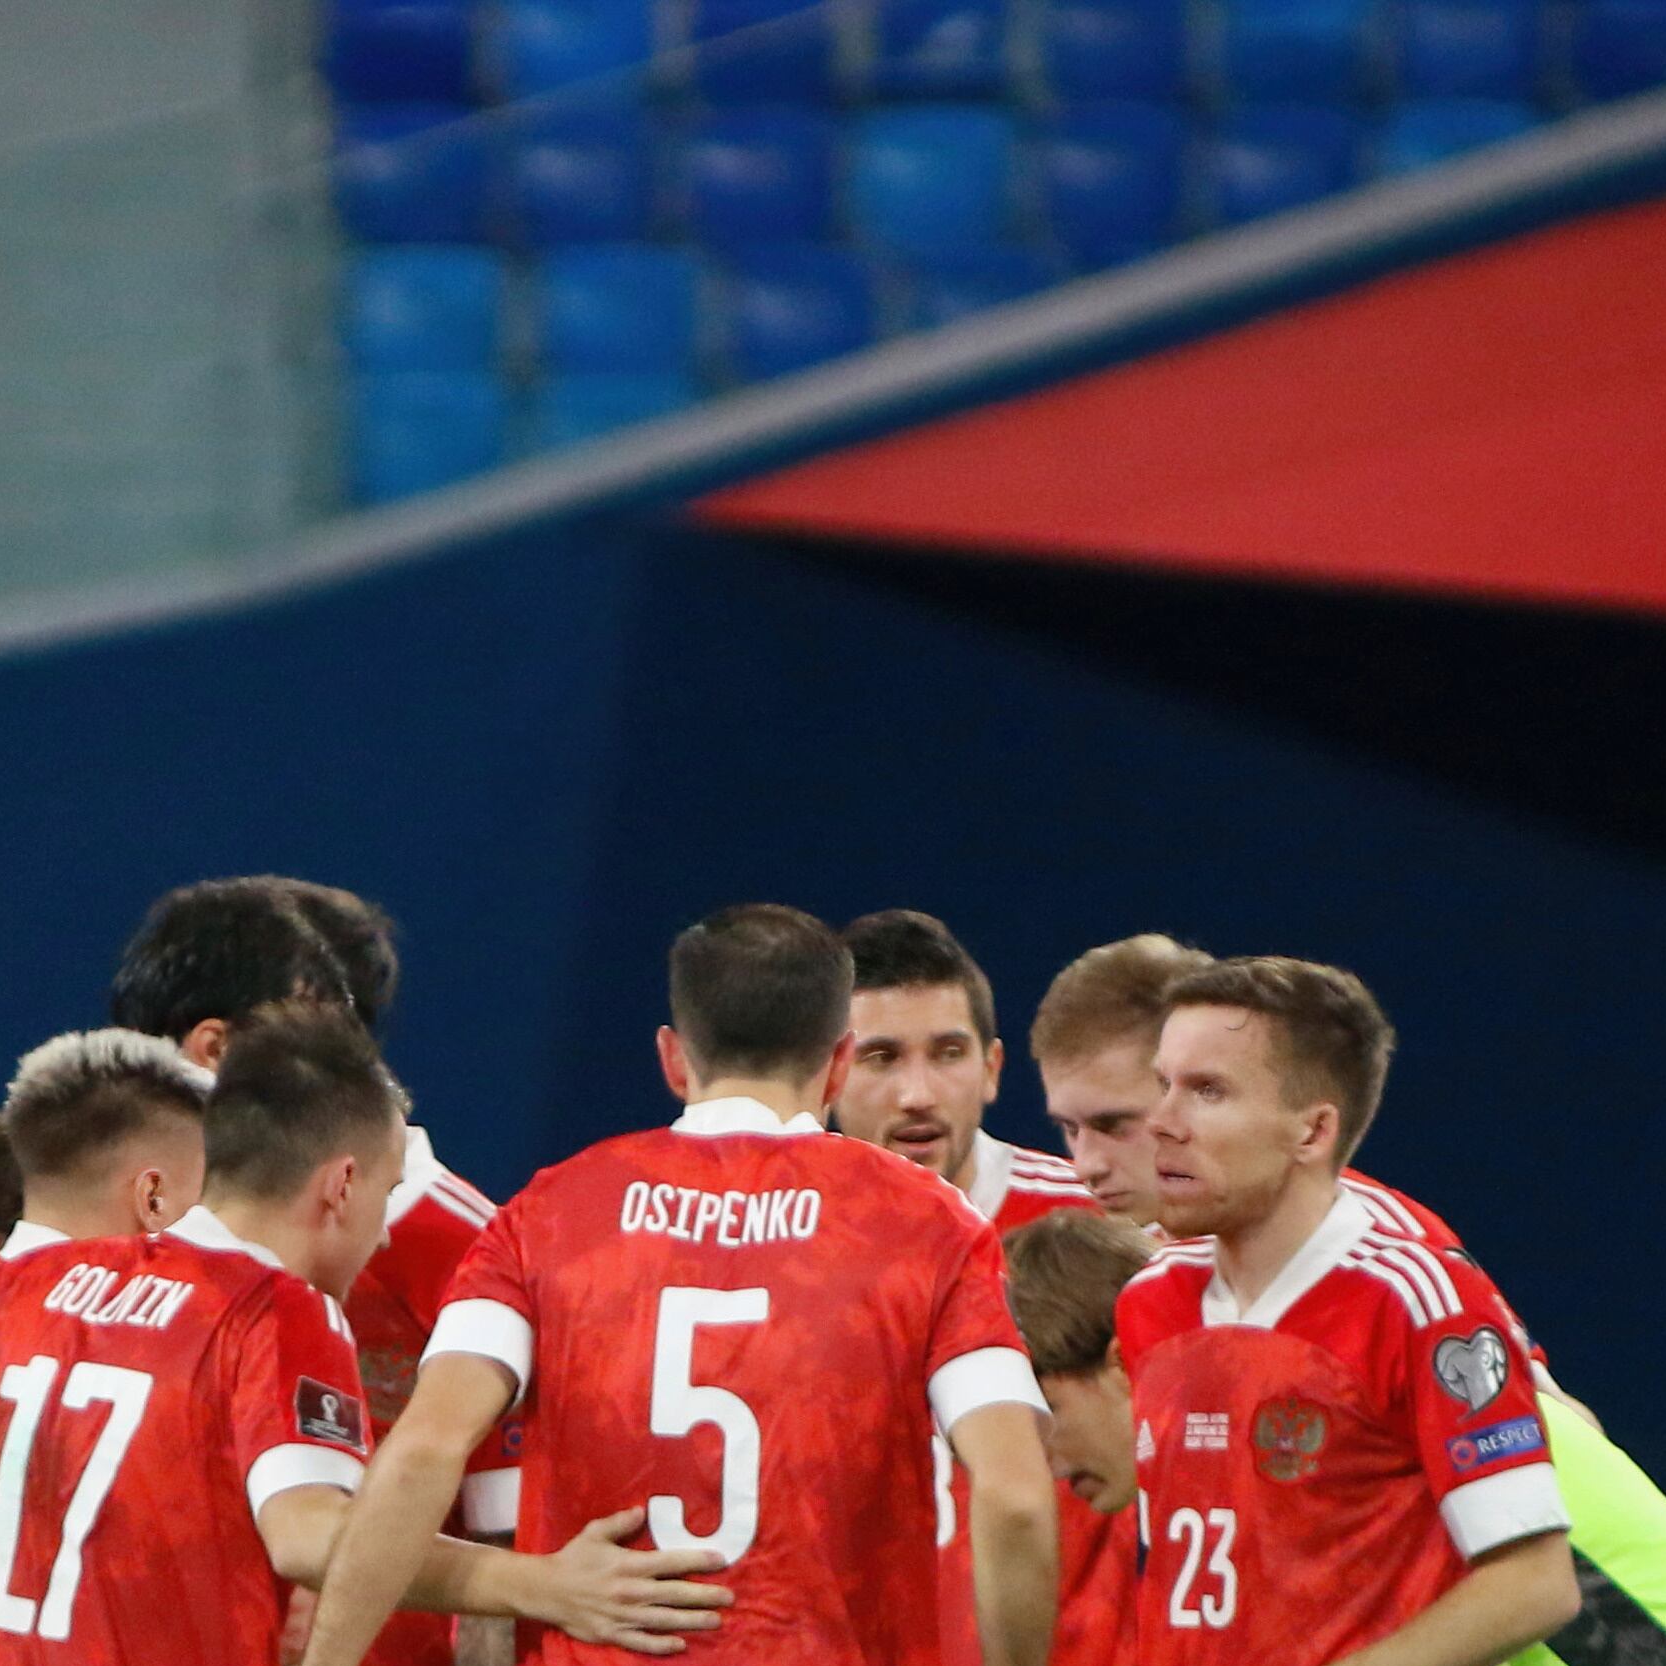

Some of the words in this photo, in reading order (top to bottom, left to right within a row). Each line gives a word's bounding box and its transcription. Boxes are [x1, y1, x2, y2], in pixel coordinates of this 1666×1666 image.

[619, 1179, 823, 1247] OSIPENKO
[647, 1285, 769, 1567] 5
[1477, 1422, 1542, 1455] RESPECT
[1167, 1506, 1238, 1629] 23
